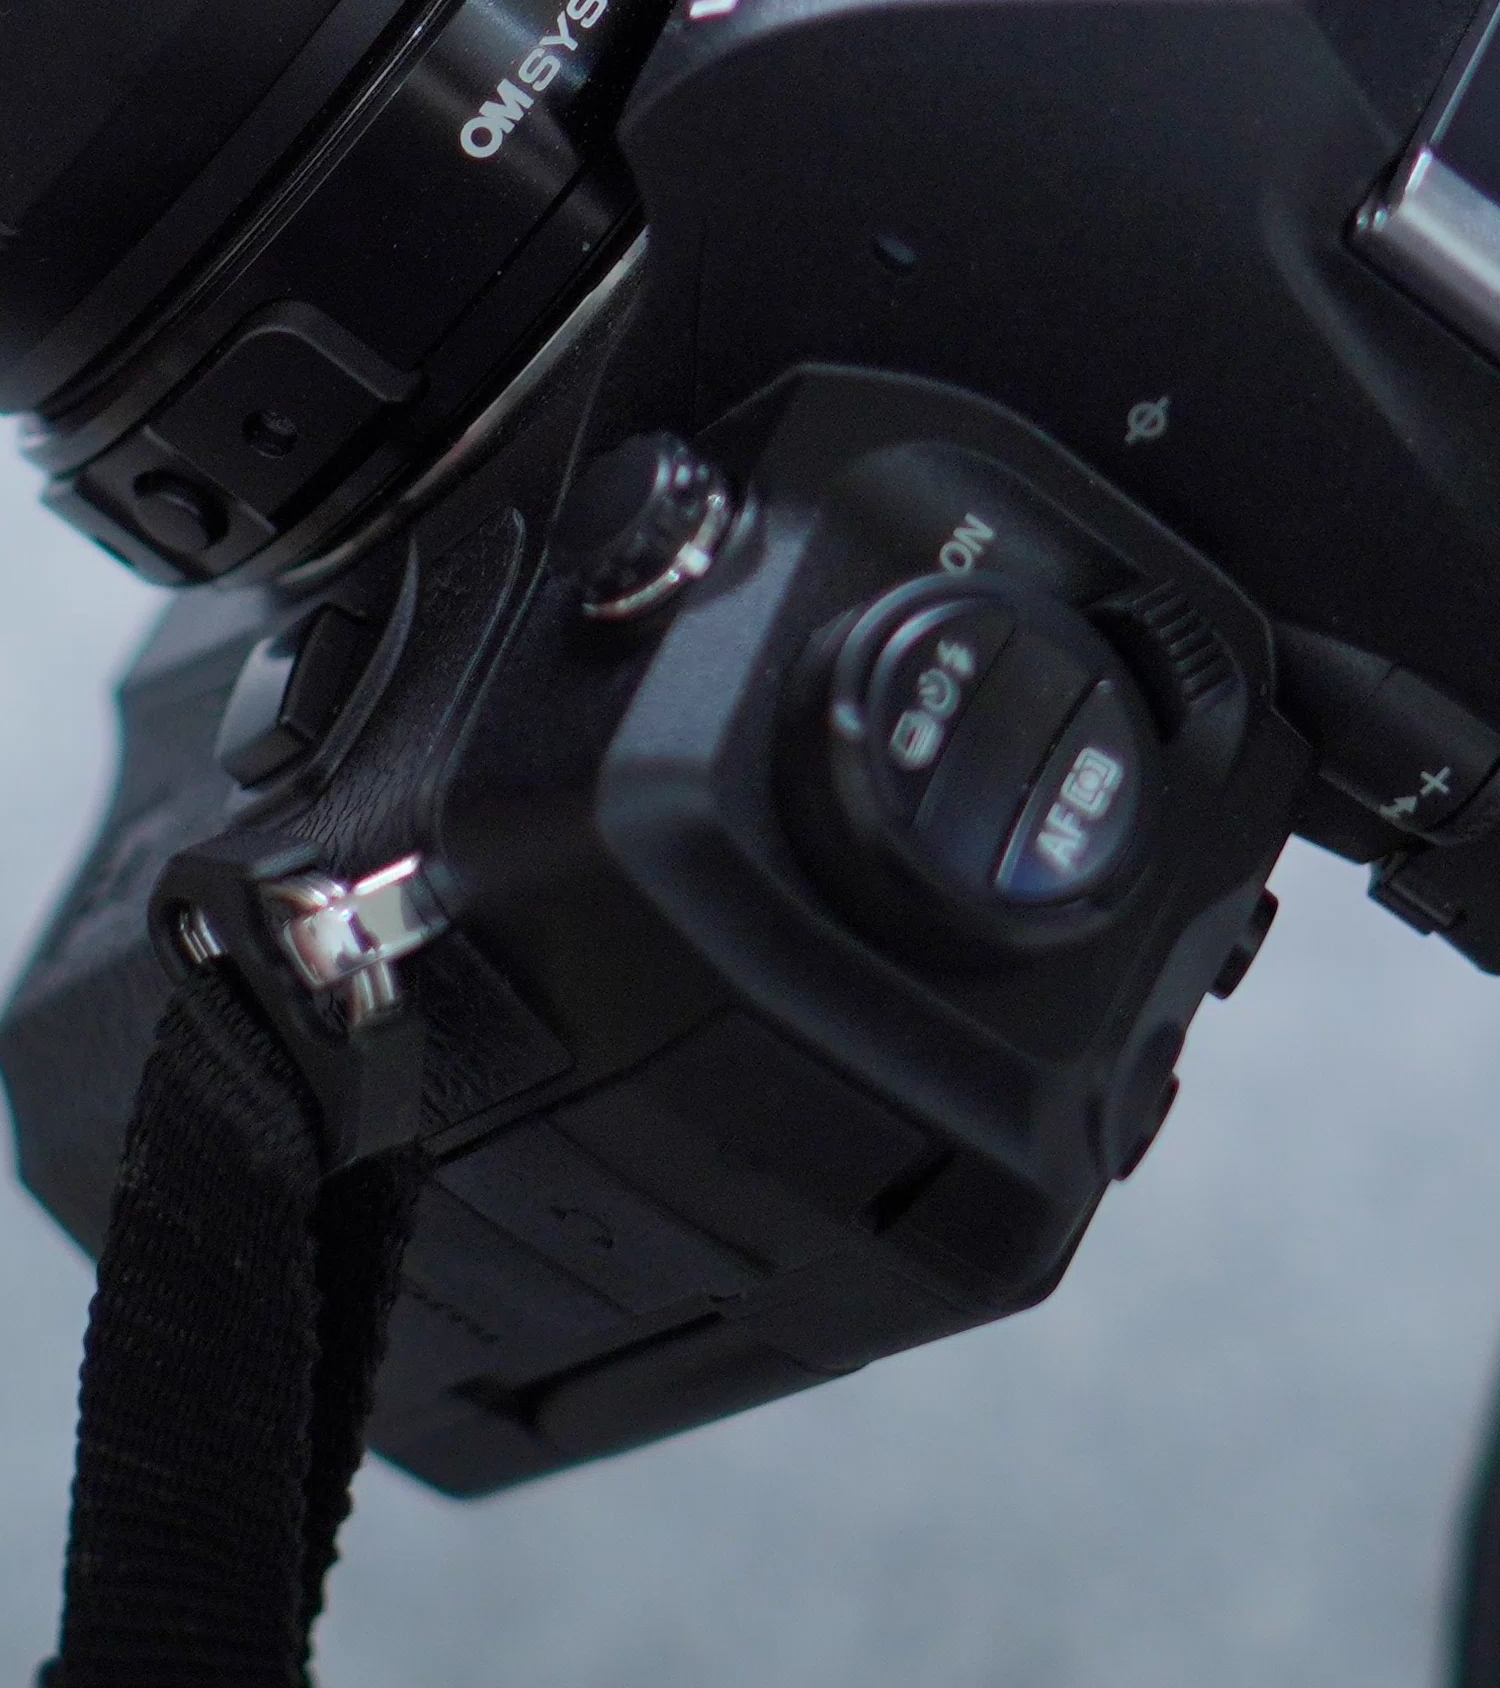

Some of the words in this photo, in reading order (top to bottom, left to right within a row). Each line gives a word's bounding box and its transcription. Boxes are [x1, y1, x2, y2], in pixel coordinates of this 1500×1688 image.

[459, 78, 533, 159] OM
[939, 512, 997, 578] ON
[1035, 800, 1087, 871] AF
